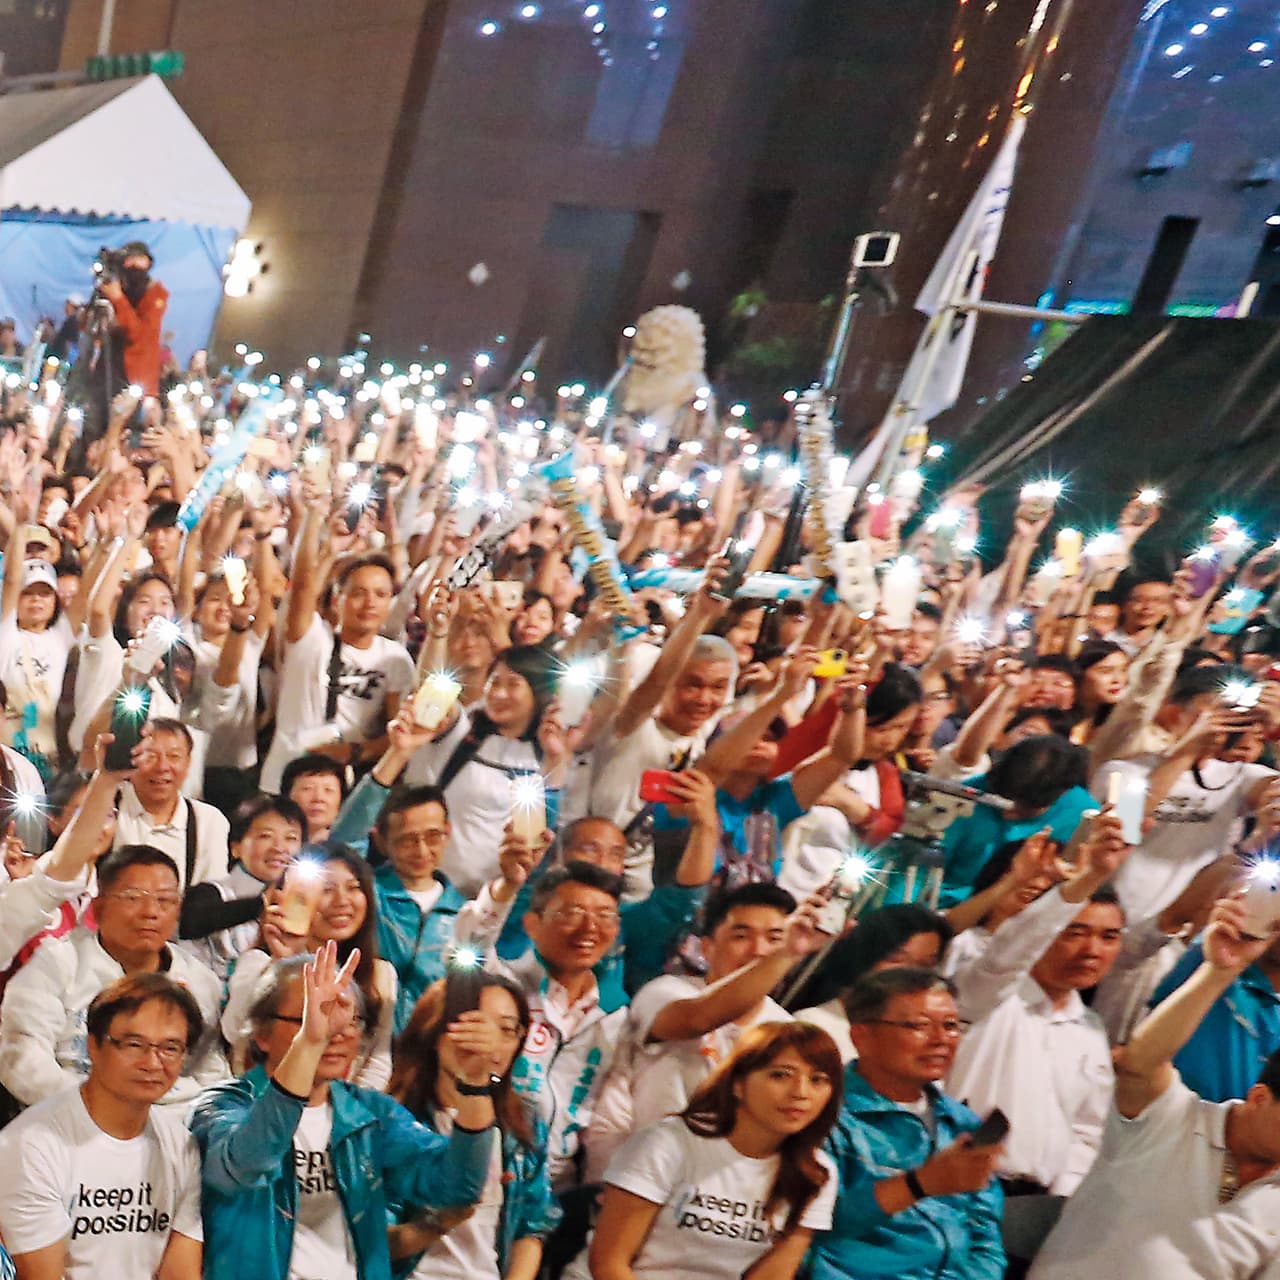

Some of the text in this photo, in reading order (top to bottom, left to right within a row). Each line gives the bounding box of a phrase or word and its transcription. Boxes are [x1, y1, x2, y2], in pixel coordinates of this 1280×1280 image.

[79, 1182, 153, 1212] keep it
[689, 1187, 748, 1222] keep
[71, 1209, 170, 1241] possible
